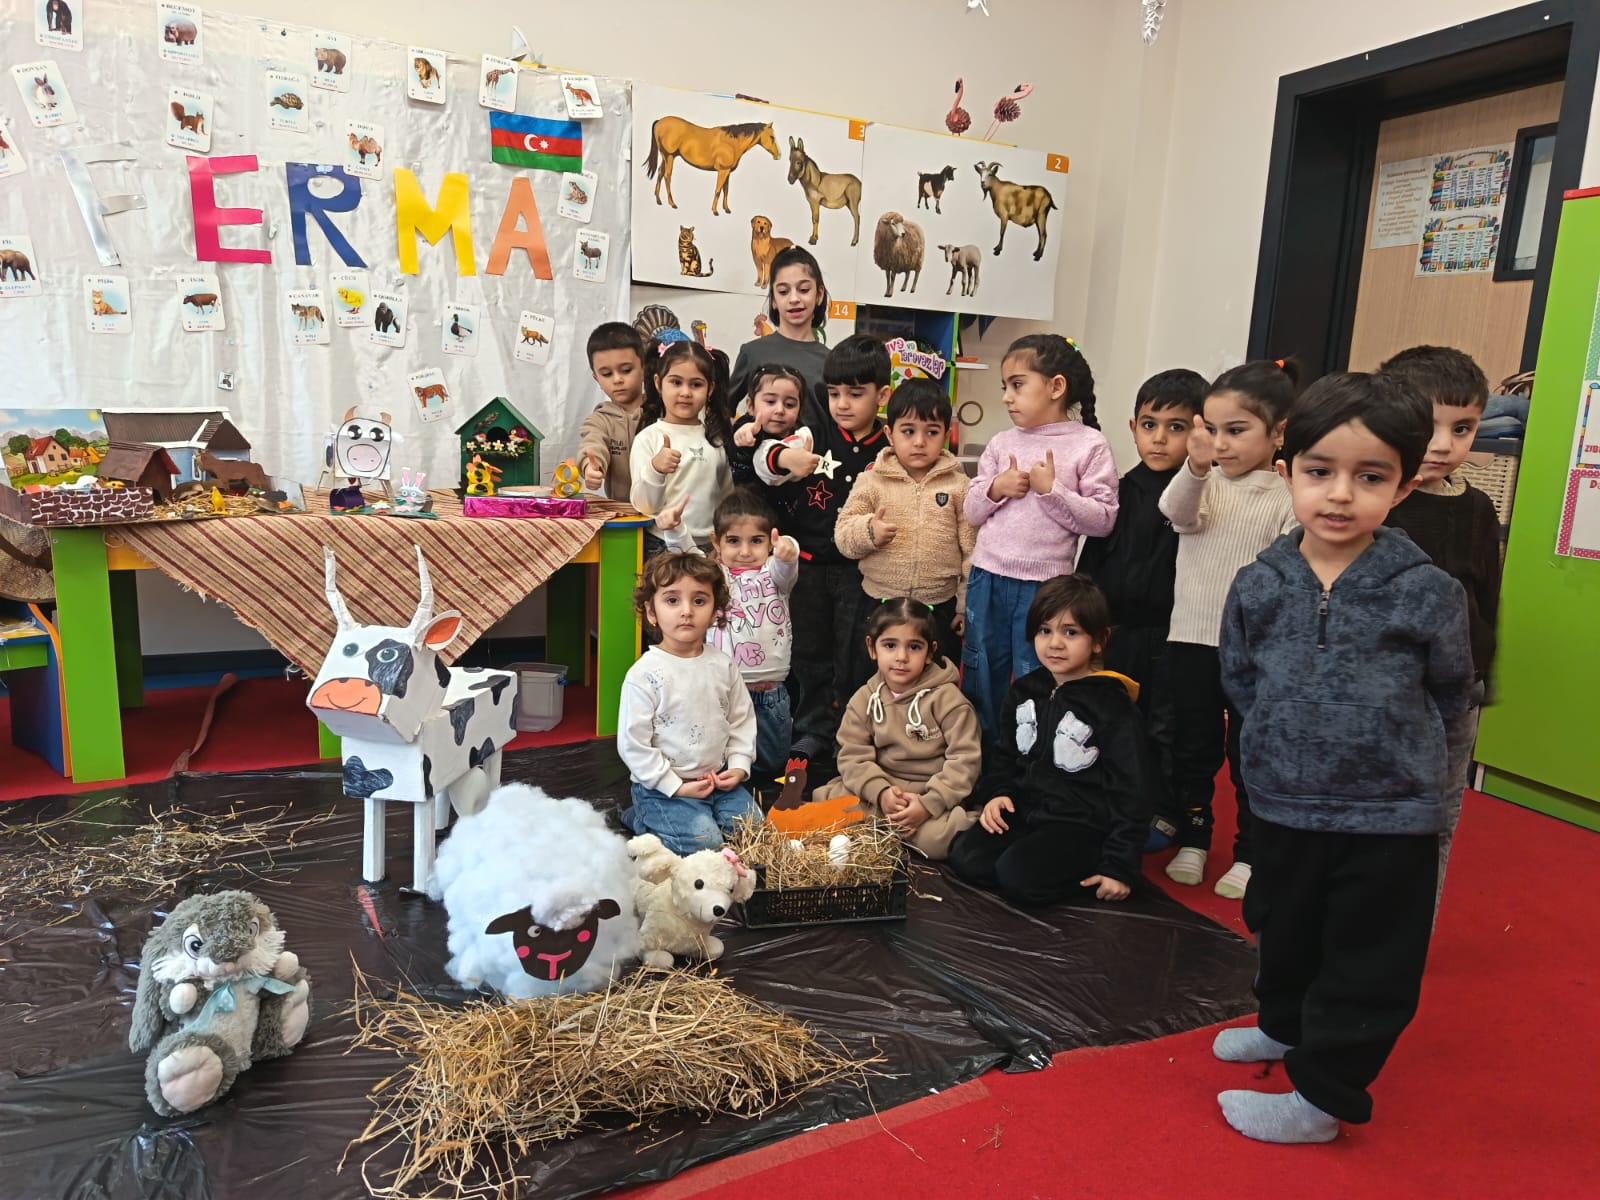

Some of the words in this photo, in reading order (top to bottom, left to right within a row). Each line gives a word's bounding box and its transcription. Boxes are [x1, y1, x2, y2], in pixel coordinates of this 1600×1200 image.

[1055, 157, 1061, 170] 2
[834, 304, 849, 316] 14
[822, 461, 829, 471] R
[746, 599, 790, 628] YO
